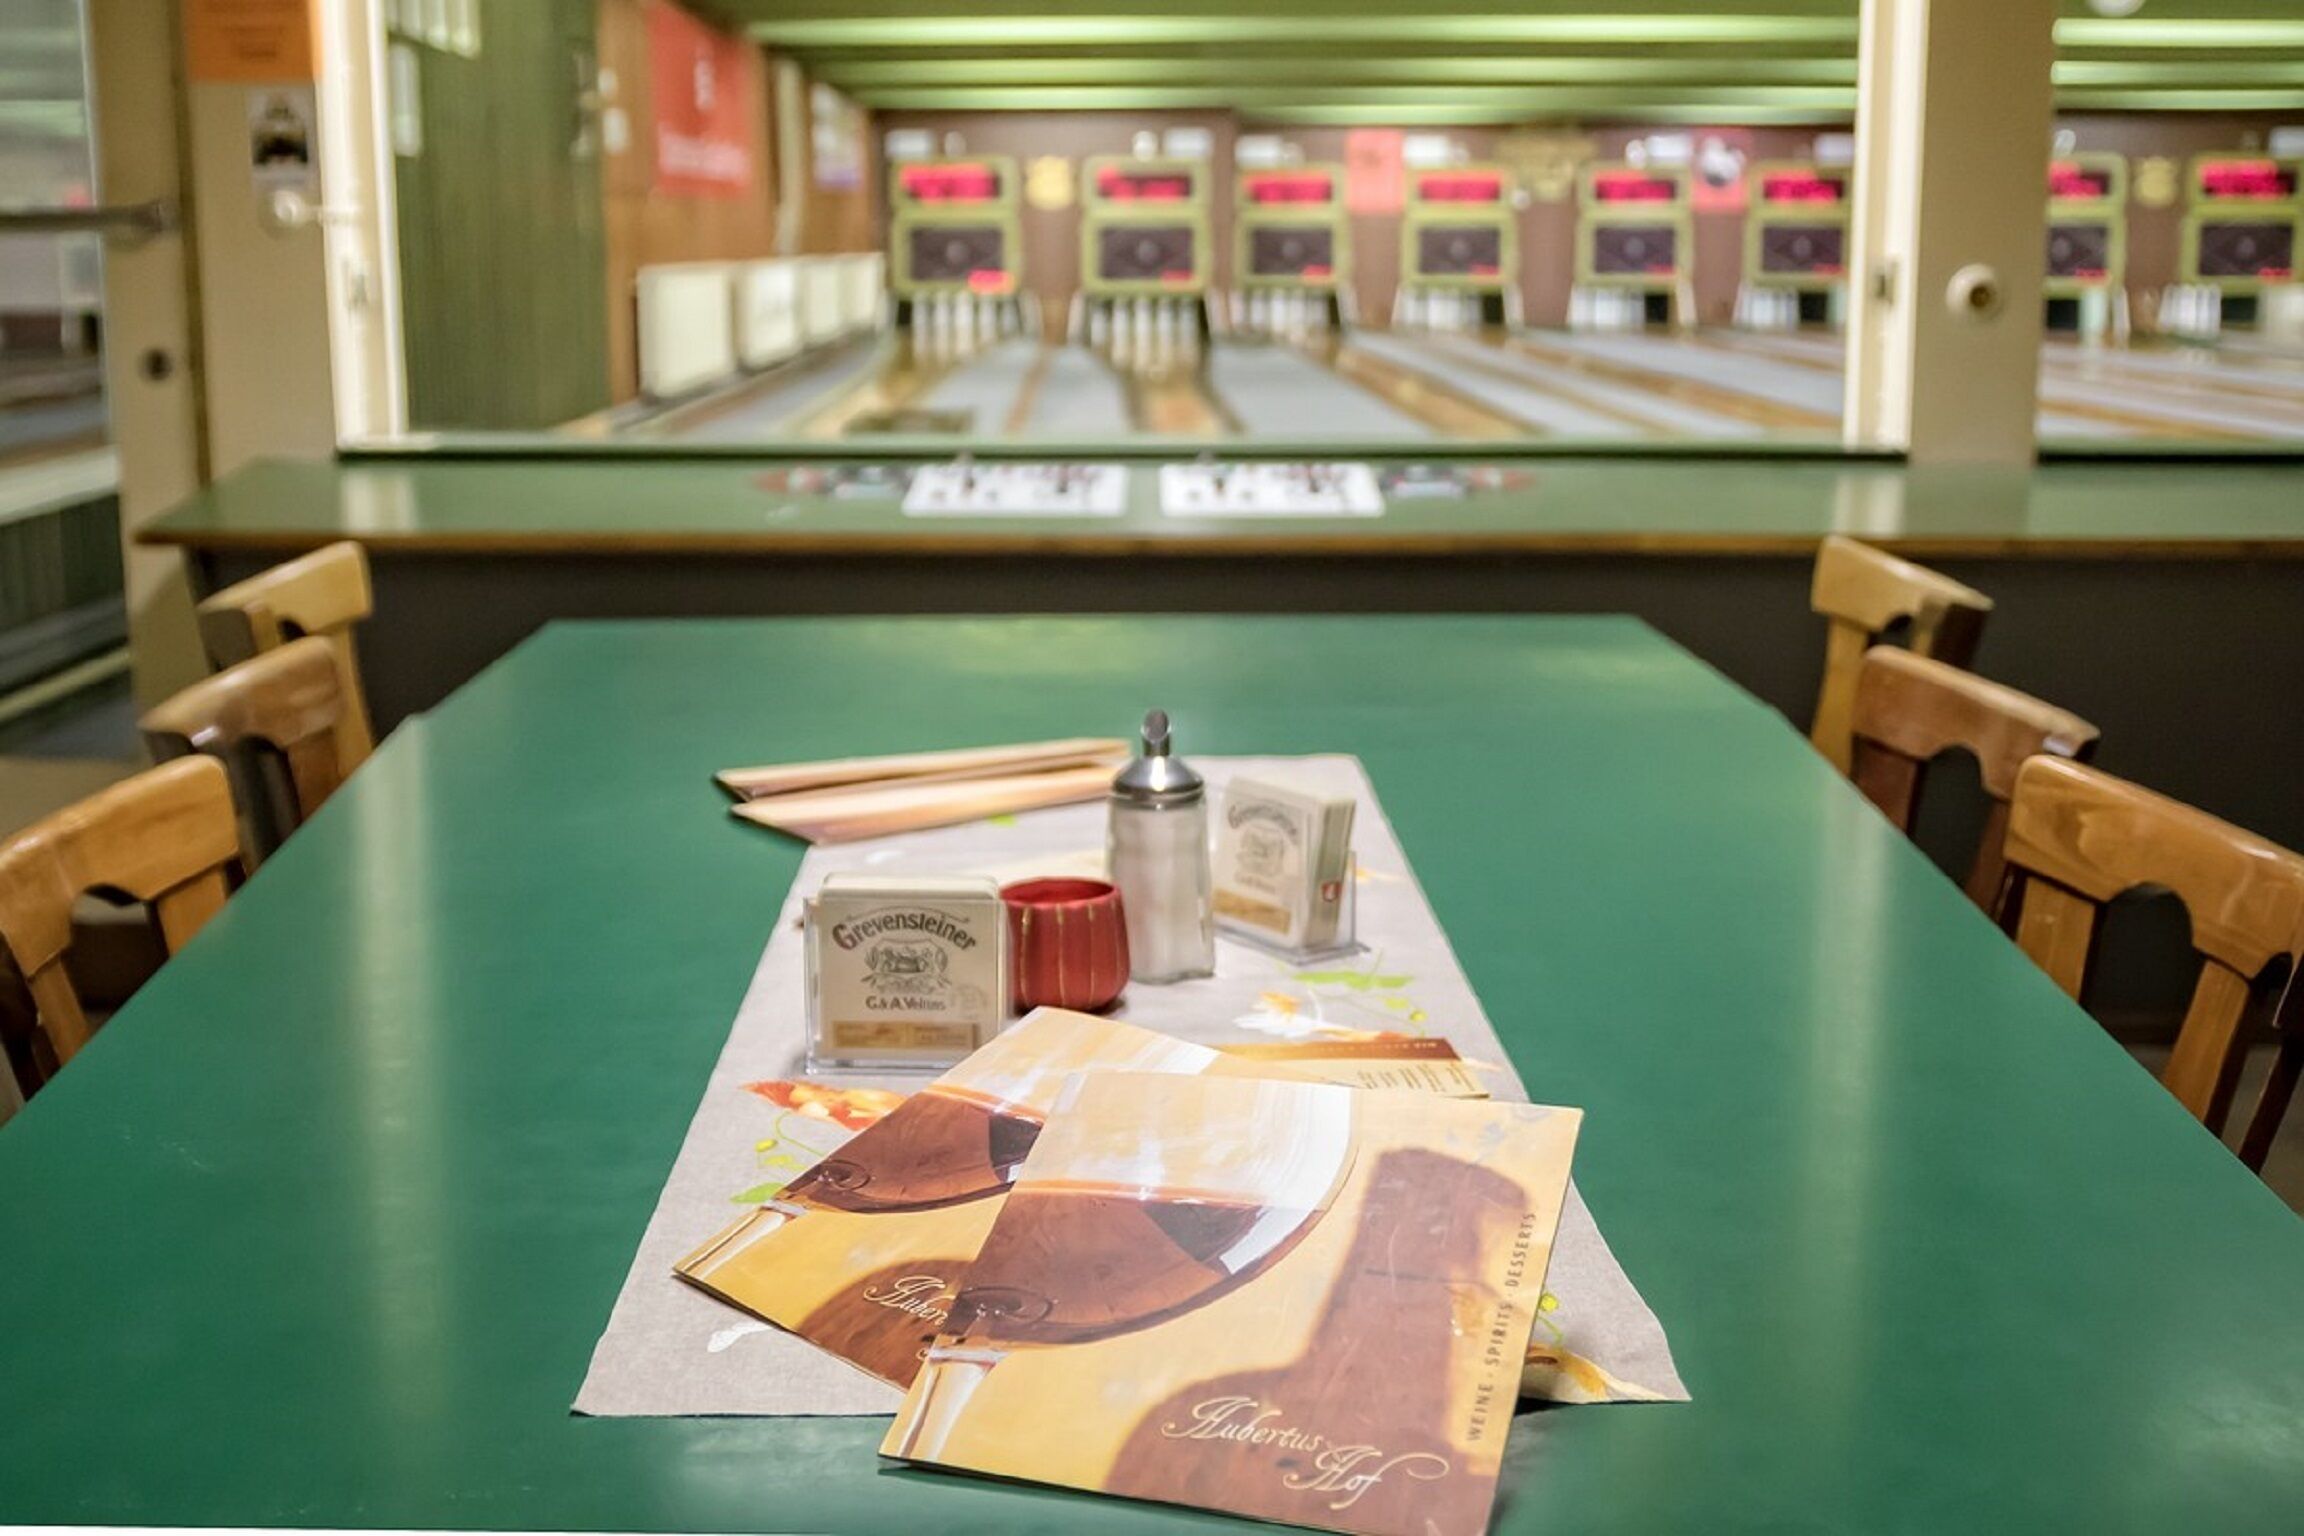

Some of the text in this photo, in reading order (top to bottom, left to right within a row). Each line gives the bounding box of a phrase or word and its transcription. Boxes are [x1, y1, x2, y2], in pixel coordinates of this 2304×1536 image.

[833, 912, 976, 951] Grevensteiner
[1467, 1212, 1537, 1441] WEINE SPIRITS DESSERTS
[1161, 1396, 1450, 1510] Hubertus Hof
